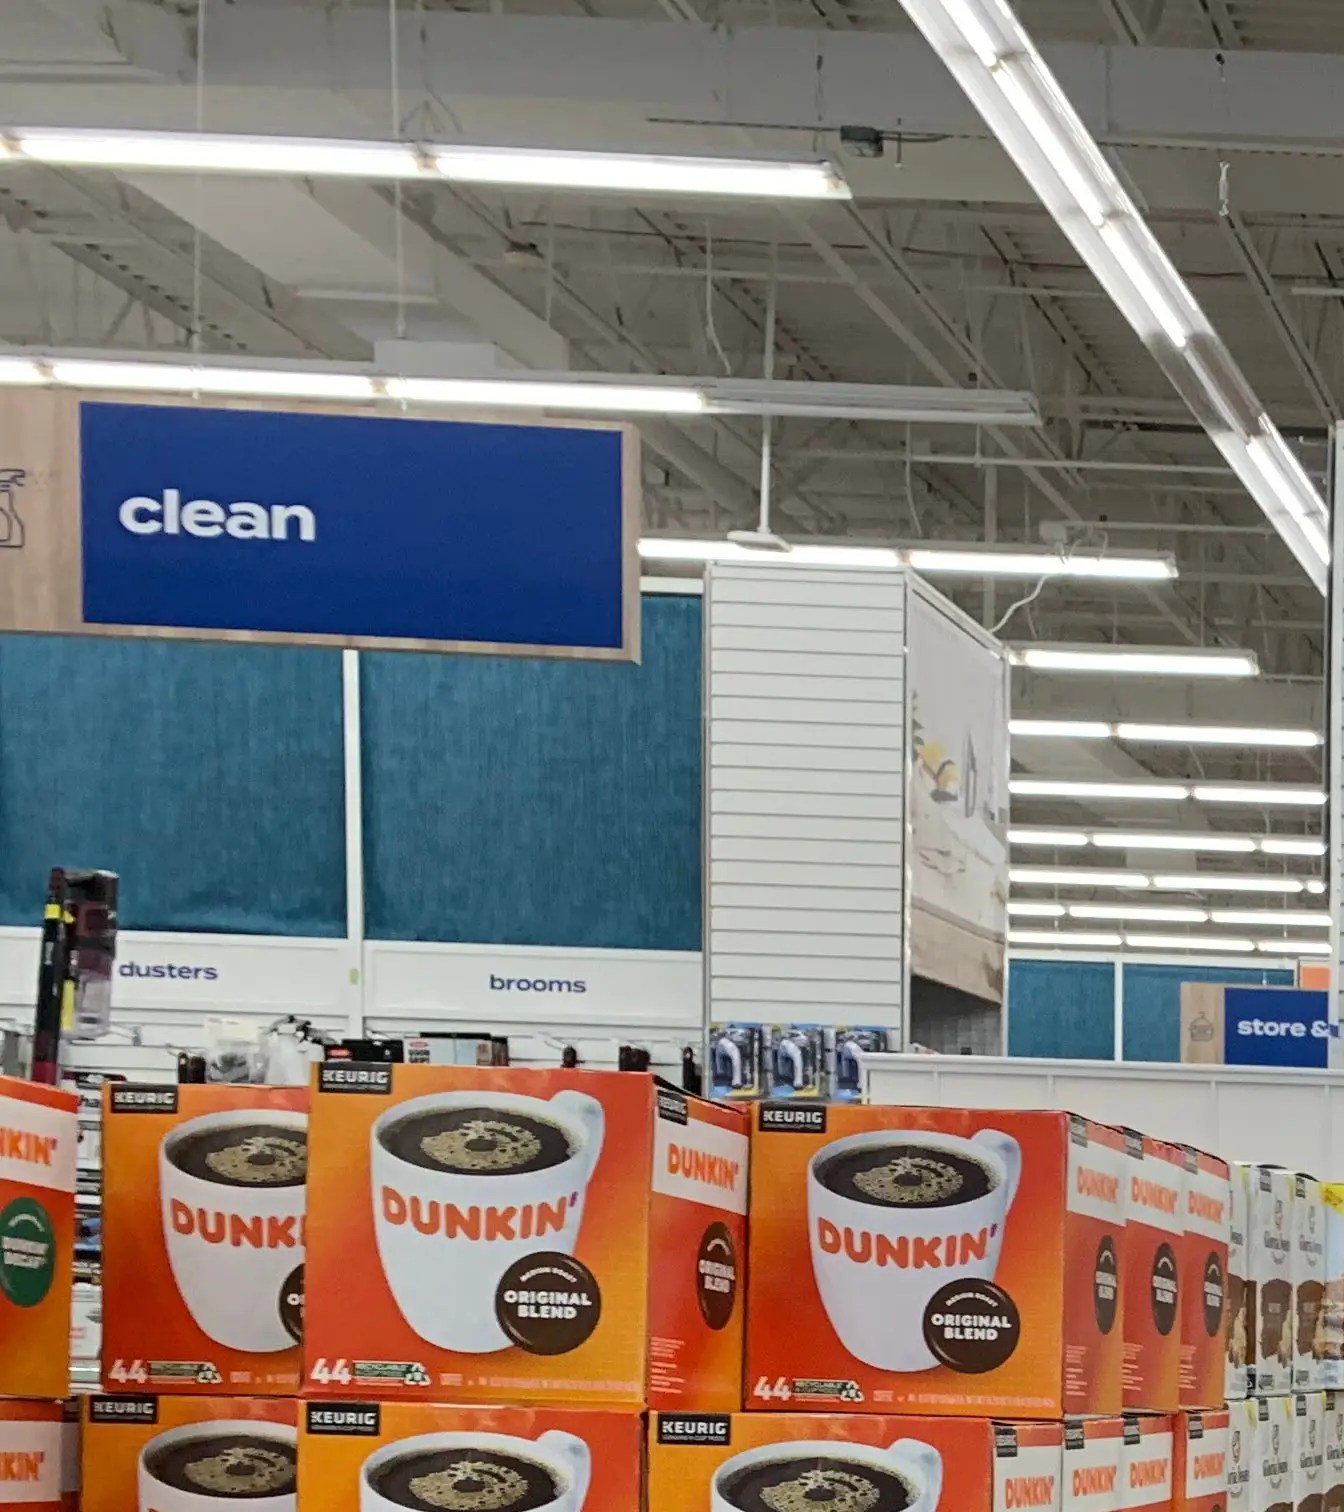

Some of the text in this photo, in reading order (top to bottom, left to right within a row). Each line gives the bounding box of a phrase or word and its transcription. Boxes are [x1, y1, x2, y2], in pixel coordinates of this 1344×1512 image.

[119, 489, 316, 541] clean
[119, 960, 217, 980] dusters
[489, 973, 586, 993] brooms
[1237, 1019, 1329, 1037] store &
[324, 1069, 387, 1084] KEURIG
[115, 1091, 175, 1104] KEURIG
[763, 1111, 823, 1126] KEURIG
[0, 1129, 57, 1166] KIN'
[667, 1142, 740, 1192] DUNKIN'
[171, 1198, 305, 1248] DUNK
[381, 1185, 578, 1241] DUNKIN'
[817, 1217, 998, 1269] DUNKIN'
[699, 1261, 735, 1281] ORIGINAL
[503, 1290, 592, 1306] ORIGINAL
[517, 1304, 577, 1320] BLEND
[931, 1313, 1011, 1329] ORIGINAL
[943, 1327, 998, 1342] BLEND
[109, 1359, 147, 1384] 44
[311, 1358, 351, 1384] 44
[754, 1376, 791, 1401] 44
[94, 1401, 153, 1416] KEURIG
[311, 1411, 375, 1426] KEURIG
[662, 1421, 726, 1435] KEURIG
[1072, 1465, 1117, 1497] DUNKIN'
[1004, 1477, 1054, 1509] DUNKIN'
